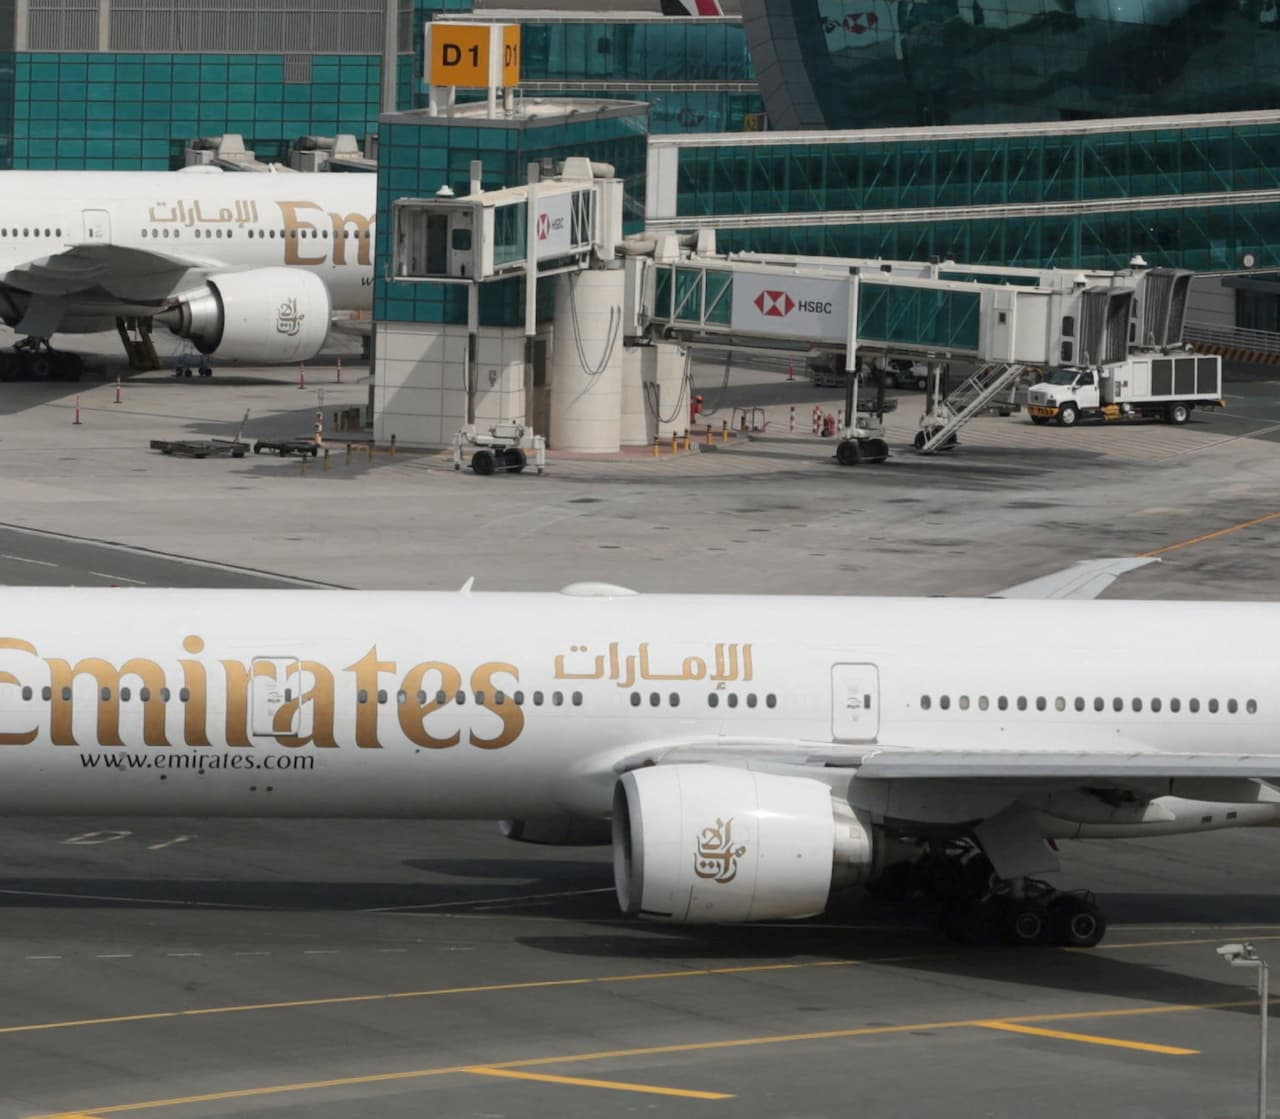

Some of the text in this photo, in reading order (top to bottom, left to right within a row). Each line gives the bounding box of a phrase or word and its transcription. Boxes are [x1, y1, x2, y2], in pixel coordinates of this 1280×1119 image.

[442, 43, 479, 68] D1
[504, 44, 518, 67] D1
[798, 300, 832, 314] HSBC
[79, 748, 316, 772] www.emirates.com
